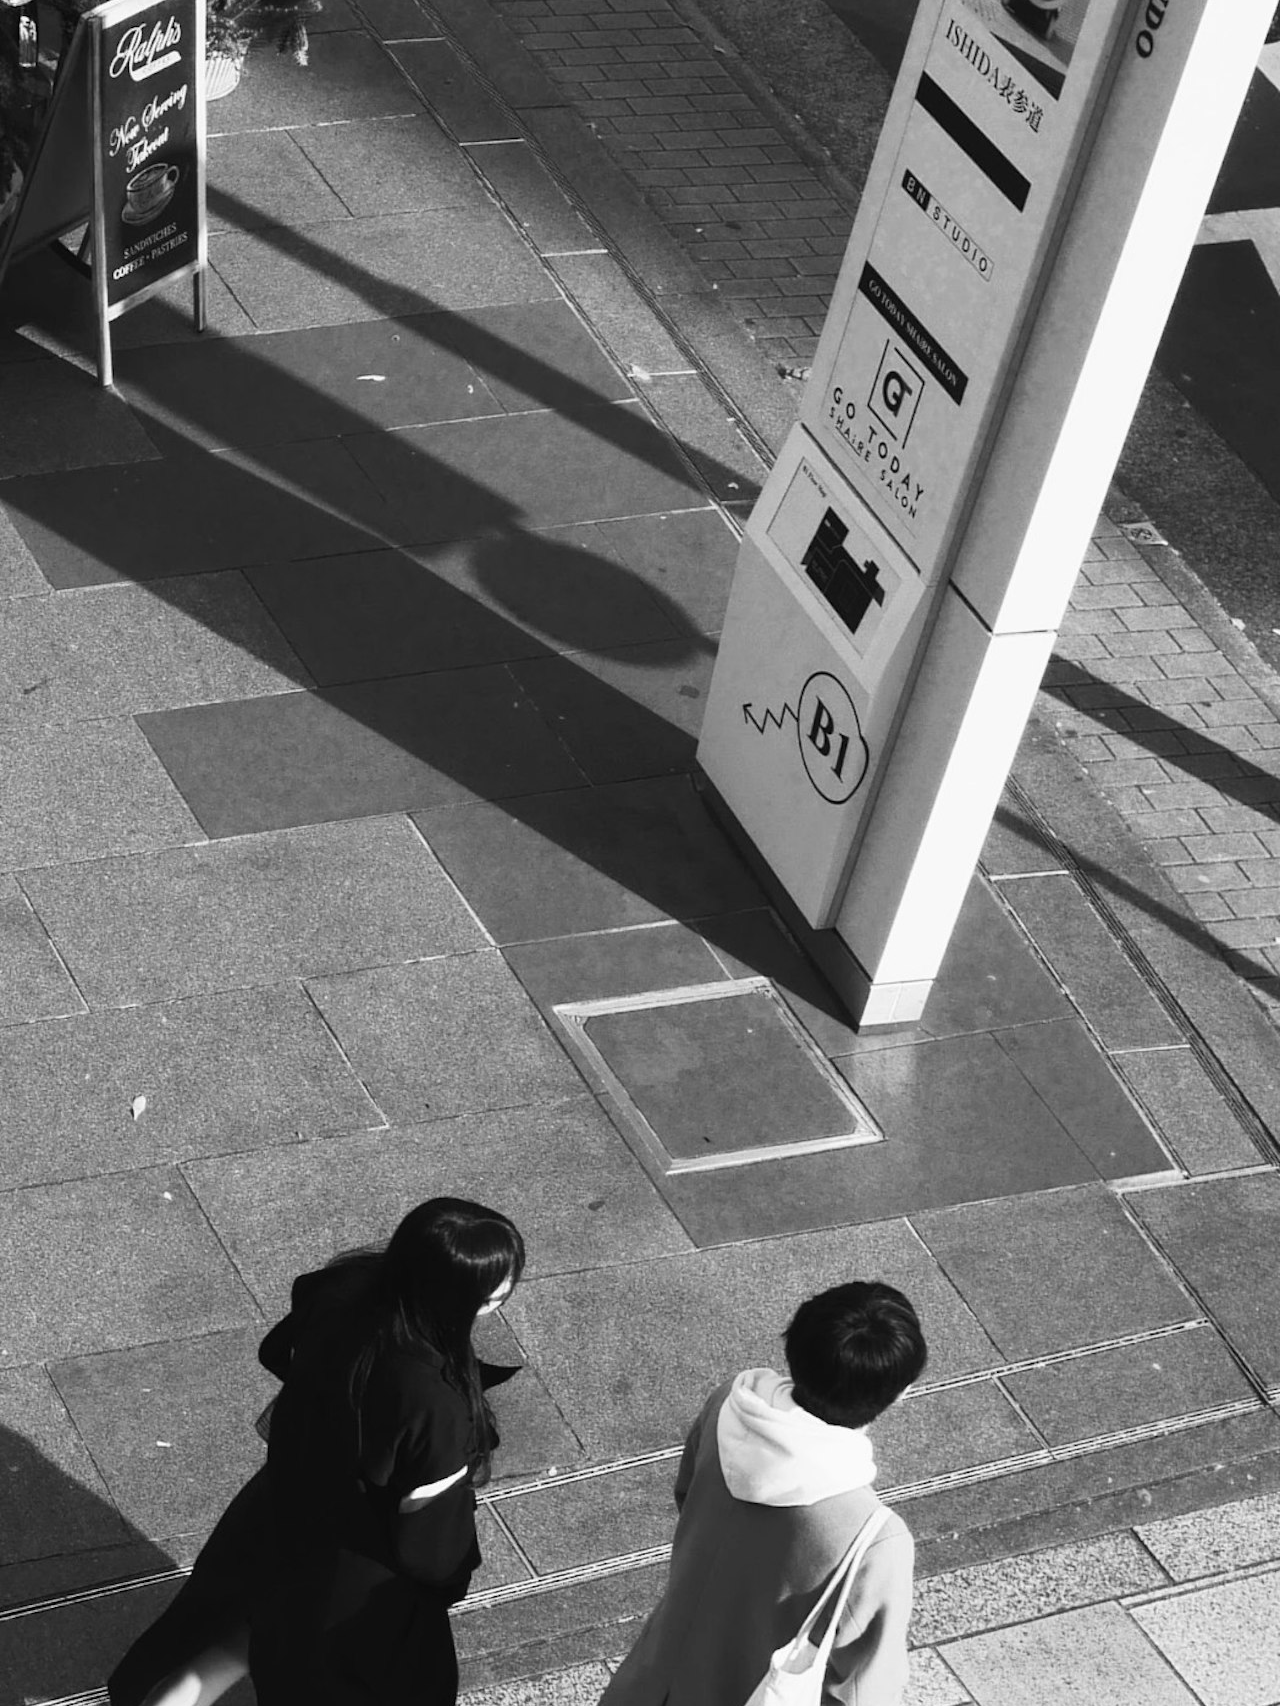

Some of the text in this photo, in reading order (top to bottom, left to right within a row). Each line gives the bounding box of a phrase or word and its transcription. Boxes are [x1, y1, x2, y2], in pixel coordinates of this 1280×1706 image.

[109, 15, 181, 80] Ralph's
[109, 84, 188, 157] Now Serving
[126, 126, 169, 173] Takeout
[113, 231, 188, 280] COFFEE PASTRIES
[123, 222, 177, 260] SANDWICHES
[906, 177, 988, 272] BN STUDIO
[833, 387, 924, 502] GO TODAY
[879, 469, 917, 519] SALON
[806, 695, 850, 784] B1
